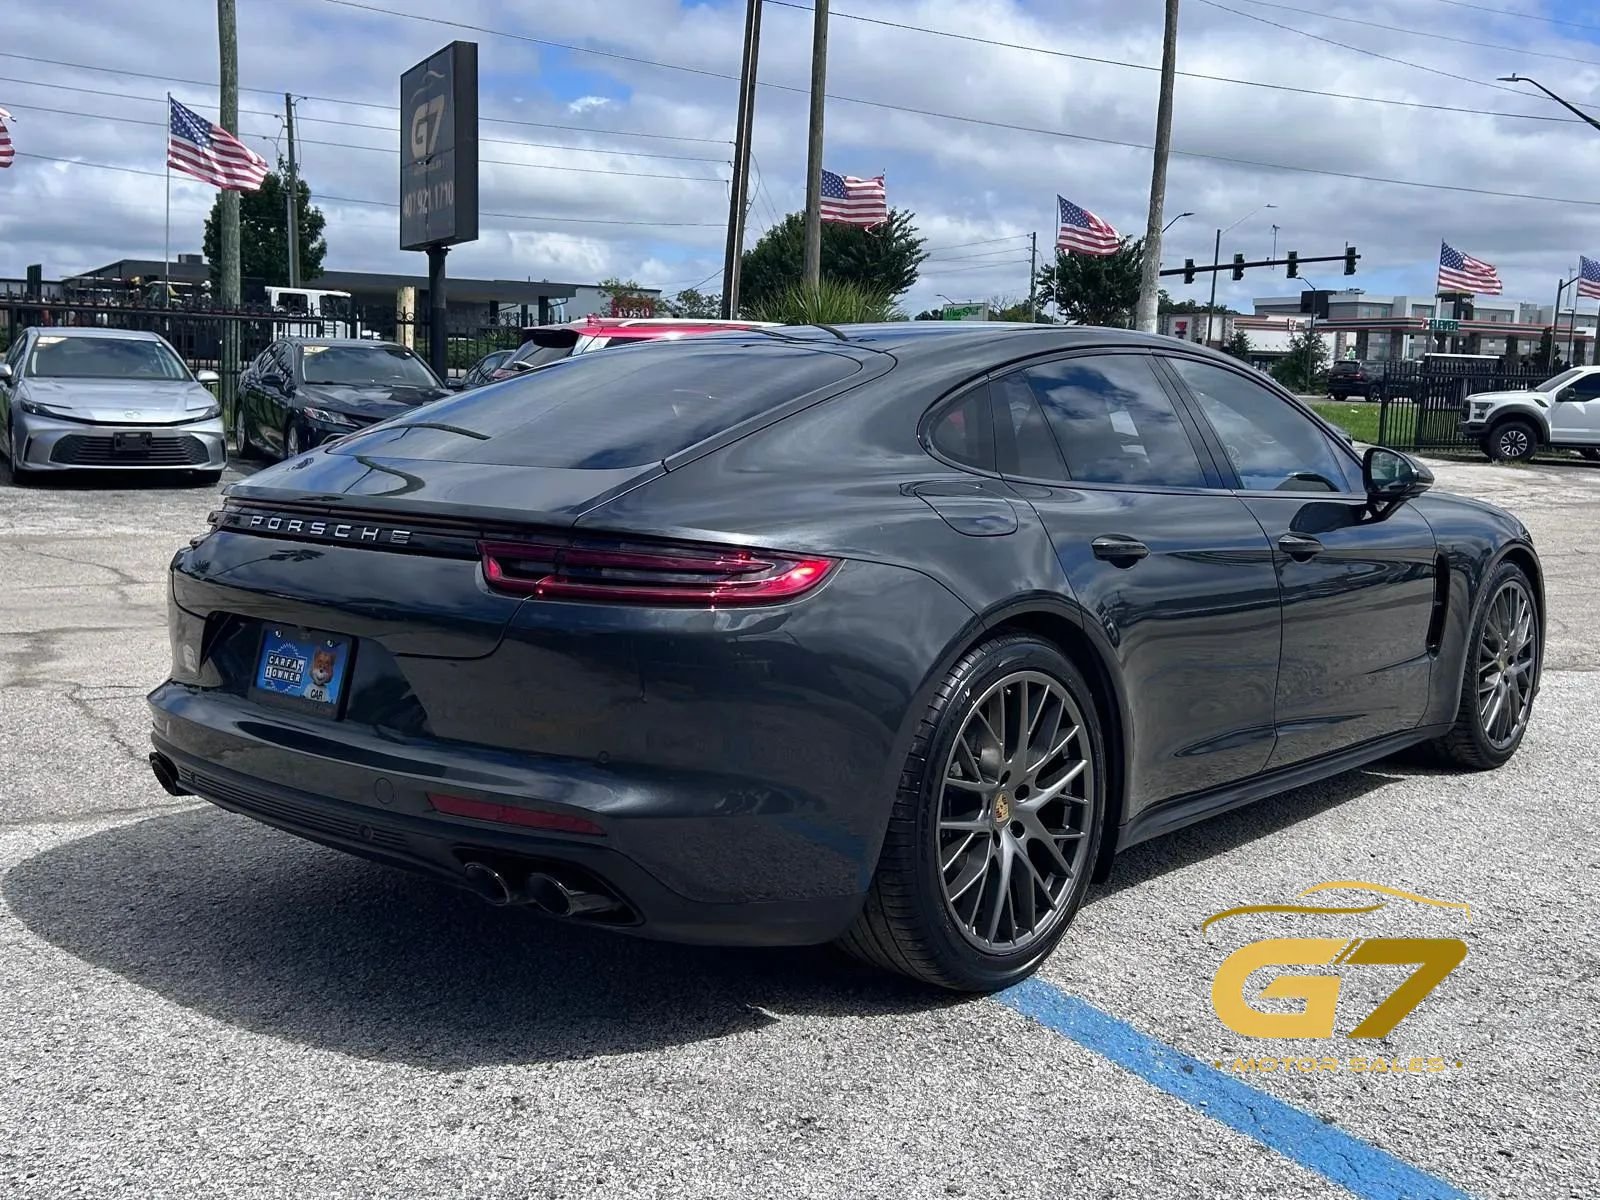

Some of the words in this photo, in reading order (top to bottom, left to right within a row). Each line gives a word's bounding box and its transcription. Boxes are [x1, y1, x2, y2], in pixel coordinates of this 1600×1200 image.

[411, 94, 445, 160] G7
[250, 515, 411, 544] PORSCHE
[268, 655, 306, 673] CARFAX
[310, 688, 324, 700] CAR
